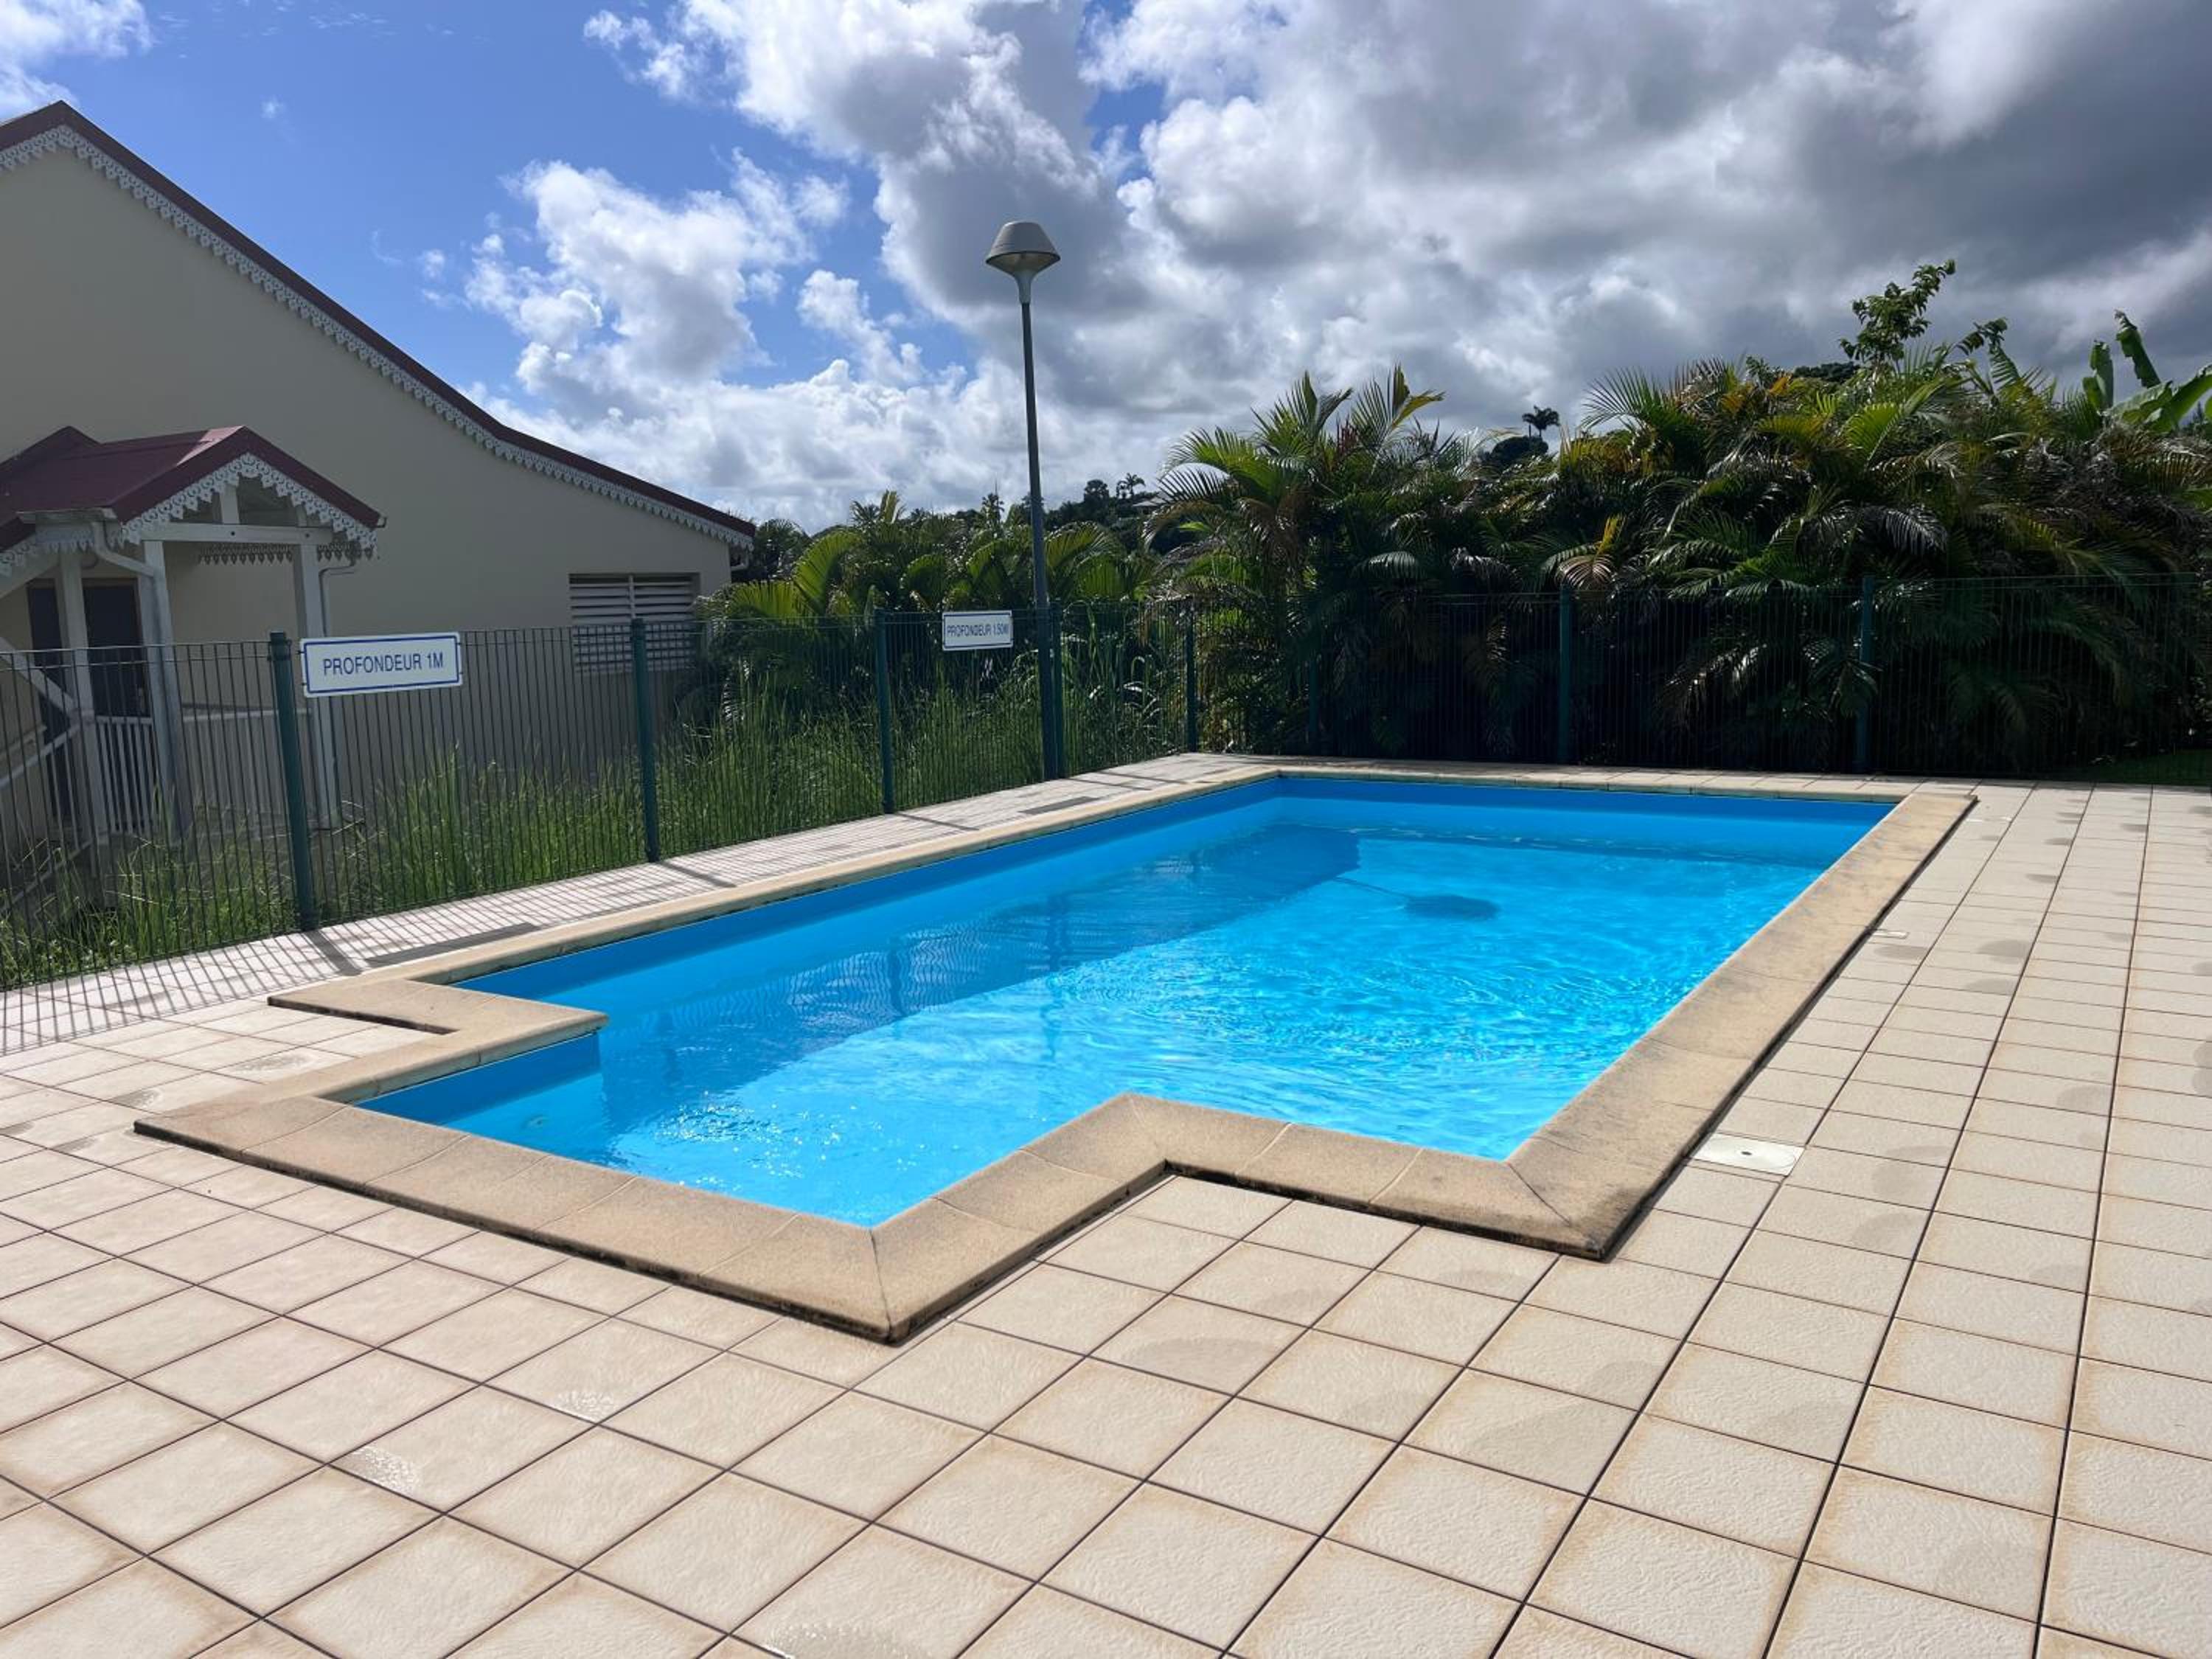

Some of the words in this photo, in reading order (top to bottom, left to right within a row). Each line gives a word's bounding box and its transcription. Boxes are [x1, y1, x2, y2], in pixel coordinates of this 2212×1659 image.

[947, 625, 991, 637] PROFONDEUR
[322, 653, 422, 675] PROFONDEUR
[426, 652, 443, 669] 1M
